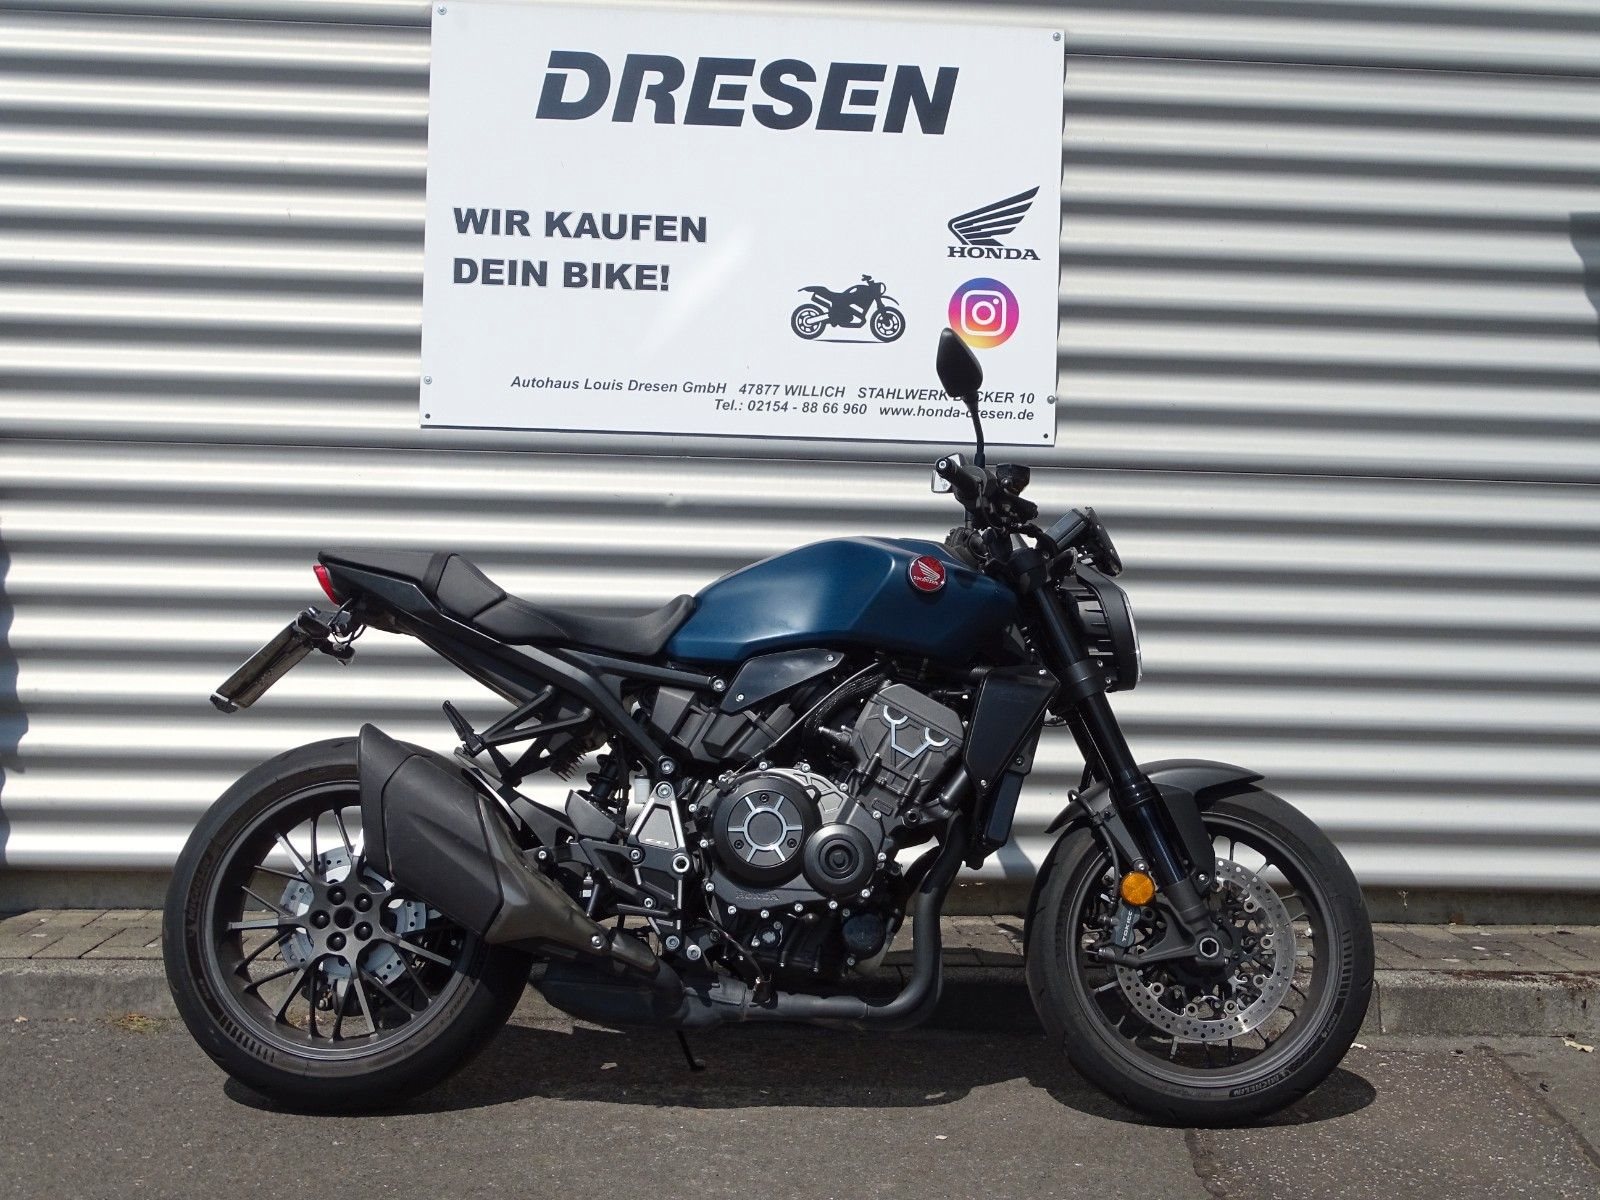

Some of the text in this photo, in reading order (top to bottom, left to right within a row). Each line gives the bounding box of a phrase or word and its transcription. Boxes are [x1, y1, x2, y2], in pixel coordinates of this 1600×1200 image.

[535, 50, 960, 135] DRESEN
[453, 207, 707, 243] WIR KAUFEN
[947, 246, 1041, 261] HONDA
[453, 257, 670, 292] DEIN BIKE!
[510, 375, 580, 390] Autohaus
[583, 378, 624, 391] Louis
[627, 379, 678, 393] Dresen
[682, 381, 727, 394] GmbH
[738, 383, 781, 396] 47877
[784, 384, 846, 398] WILLICH
[857, 386, 949, 401] STAHLWERK
[1019, 392, 1035, 404] 10
[714, 398, 743, 411] Tel.:
[747, 399, 789, 413] 02154
[801, 401, 819, 413] 88
[822, 402, 839, 414] 66
[842, 402, 868, 415] 960
